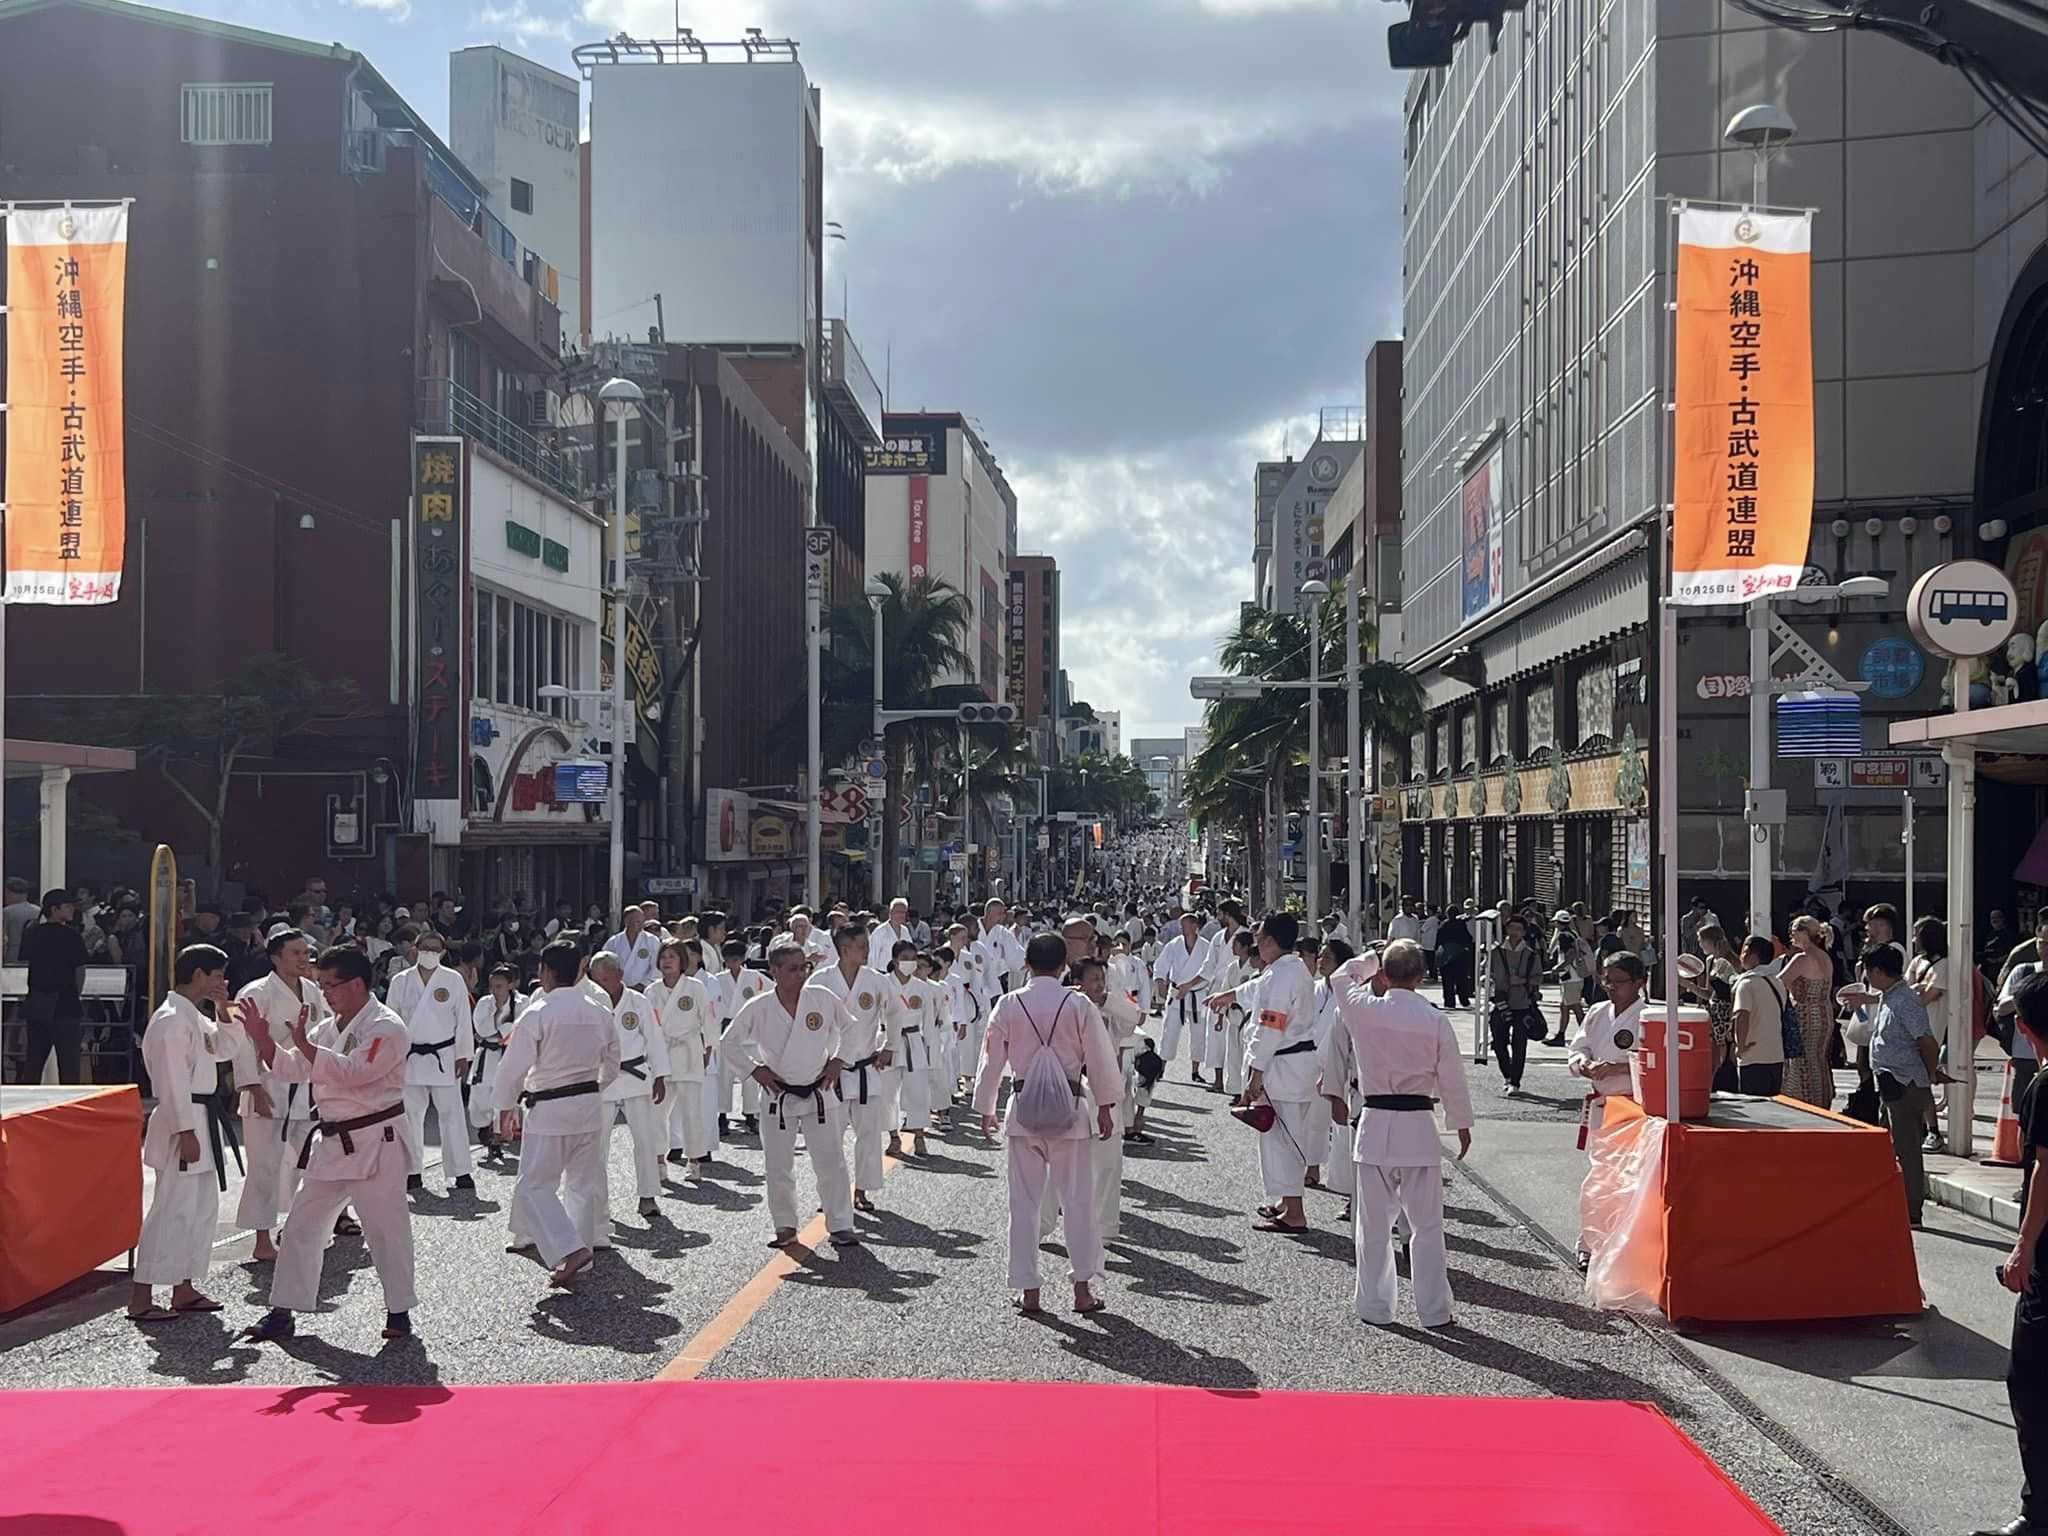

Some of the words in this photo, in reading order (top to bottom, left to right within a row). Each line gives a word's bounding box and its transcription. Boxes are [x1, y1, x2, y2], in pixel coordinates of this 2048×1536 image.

[55, 256, 86, 559] 沖縄空手・古武道連盟
[1726, 259, 1761, 557] 沖縄空手・古武道連盟
[808, 535, 829, 552] 3F
[1680, 584, 1735, 596] 10月25日は
